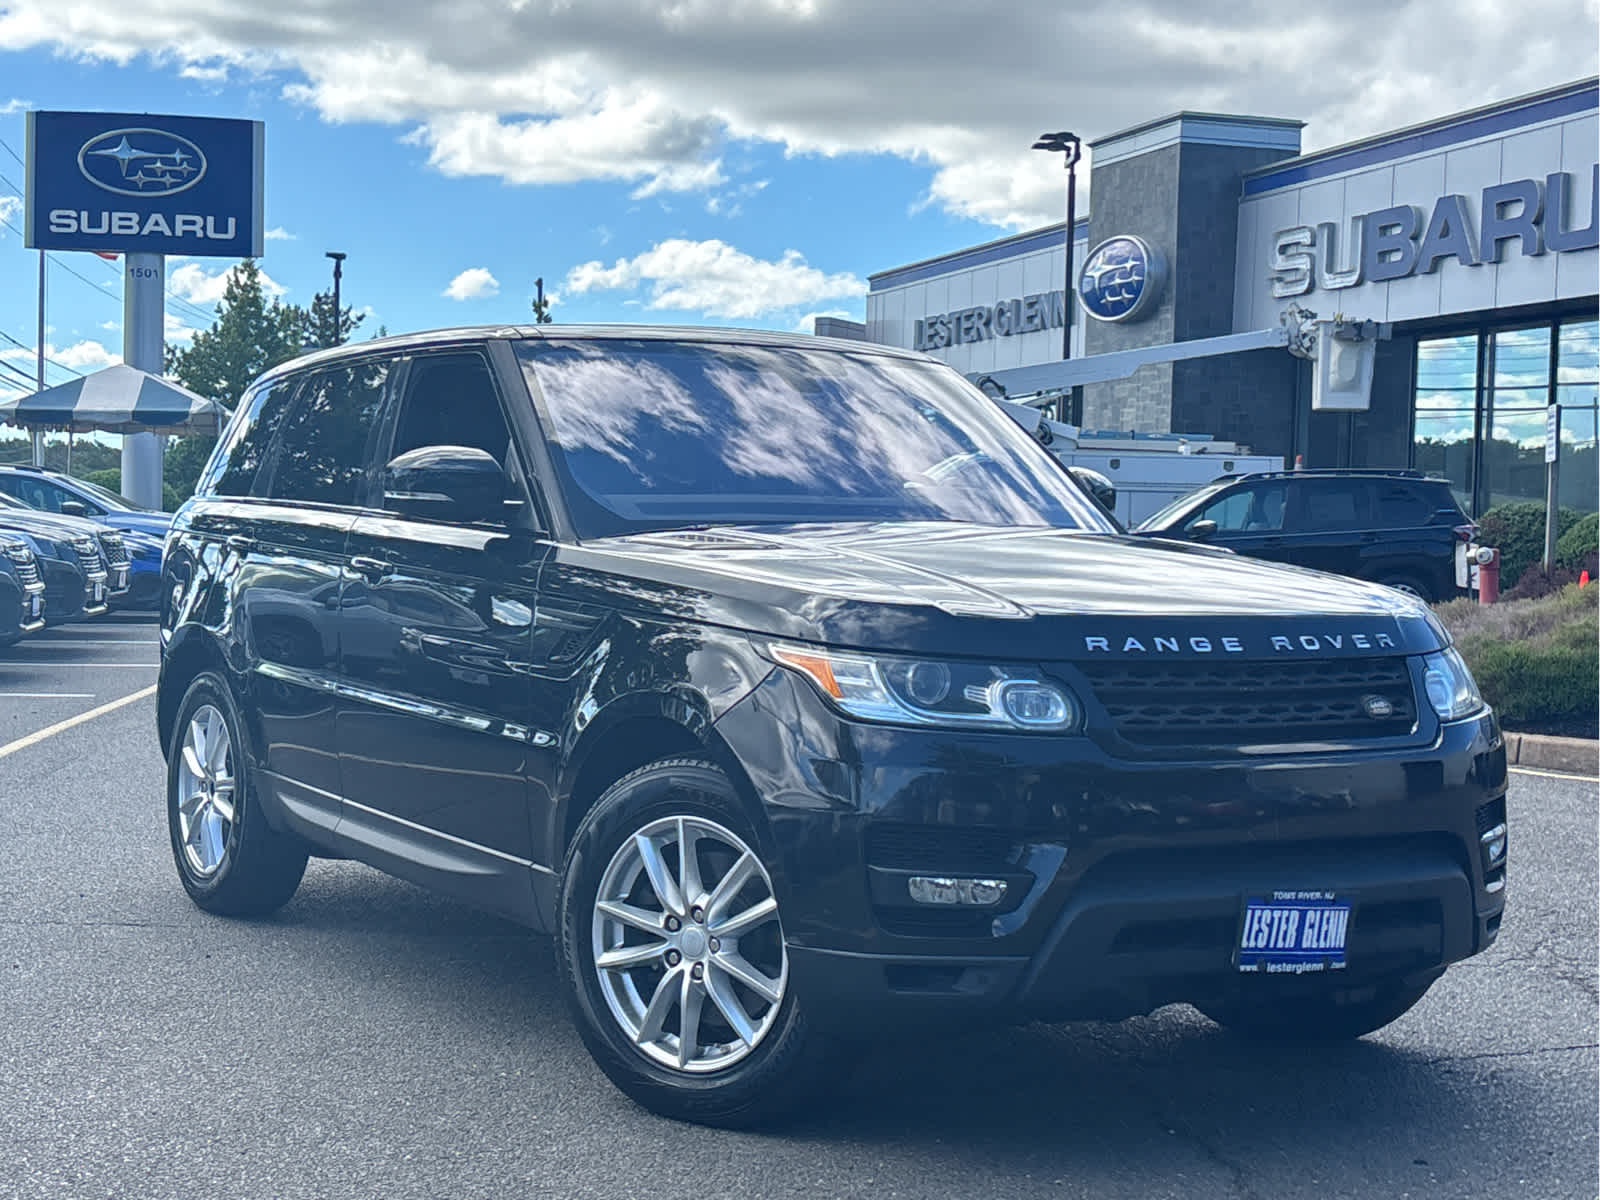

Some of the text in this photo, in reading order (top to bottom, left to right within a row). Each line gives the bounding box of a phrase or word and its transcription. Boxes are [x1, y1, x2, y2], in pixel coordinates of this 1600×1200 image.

[49, 209, 236, 240] SUBARU
[1270, 164, 1600, 299] SUBARU
[130, 267, 159, 279] 1501
[914, 306, 992, 351] LESTER
[1085, 633, 1396, 652] RANGE ROVER
[1241, 909, 1349, 948] LESTER GLENN
[1266, 962, 1324, 974] lesterglenn
